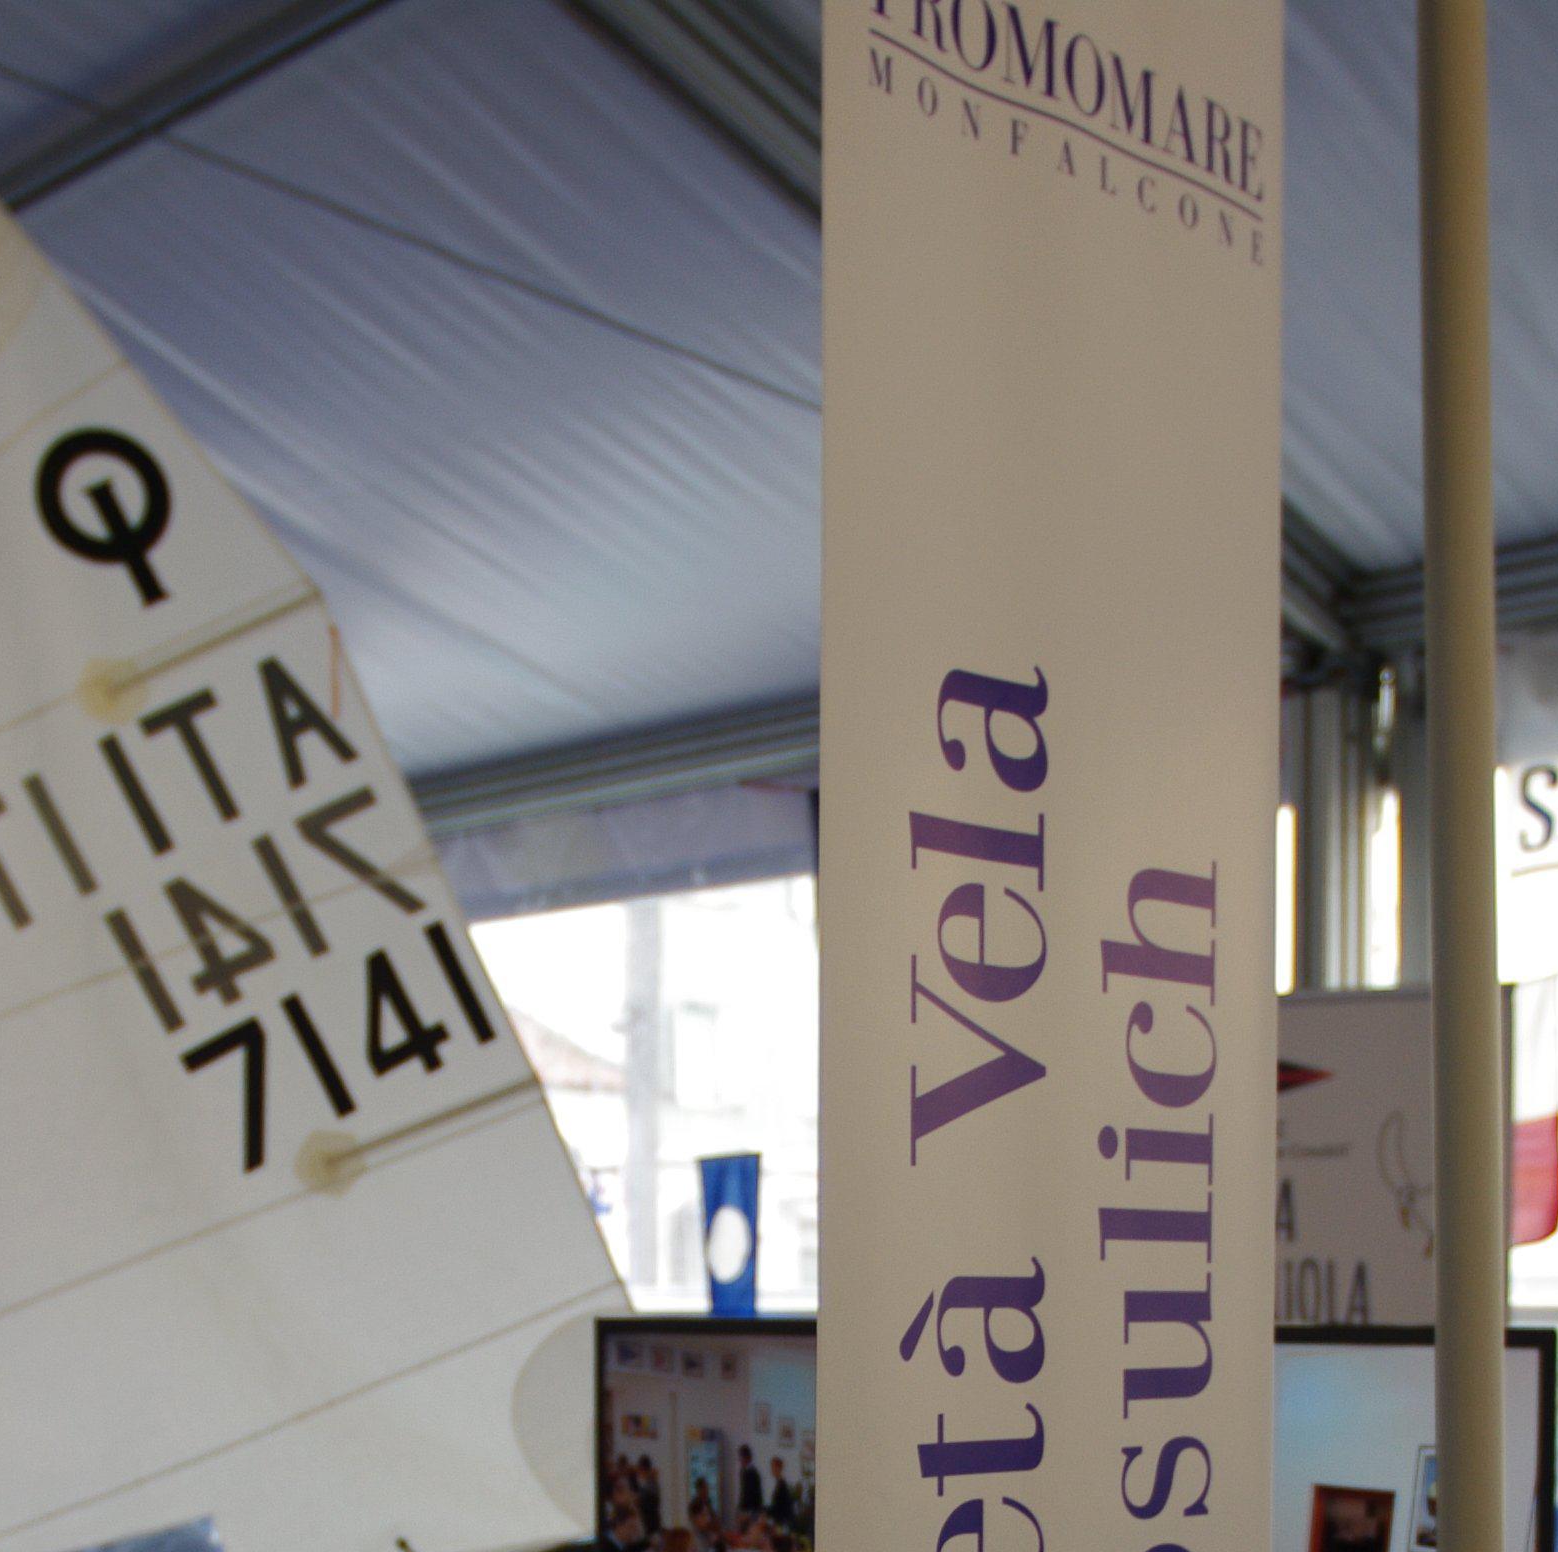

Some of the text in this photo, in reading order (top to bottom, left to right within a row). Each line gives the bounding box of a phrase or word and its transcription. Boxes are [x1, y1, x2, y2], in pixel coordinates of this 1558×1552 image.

[869, 47, 1263, 266] MONFALCONE
[908, 664, 1050, 1167] Vela
[179, 920, 495, 1173] 7141
